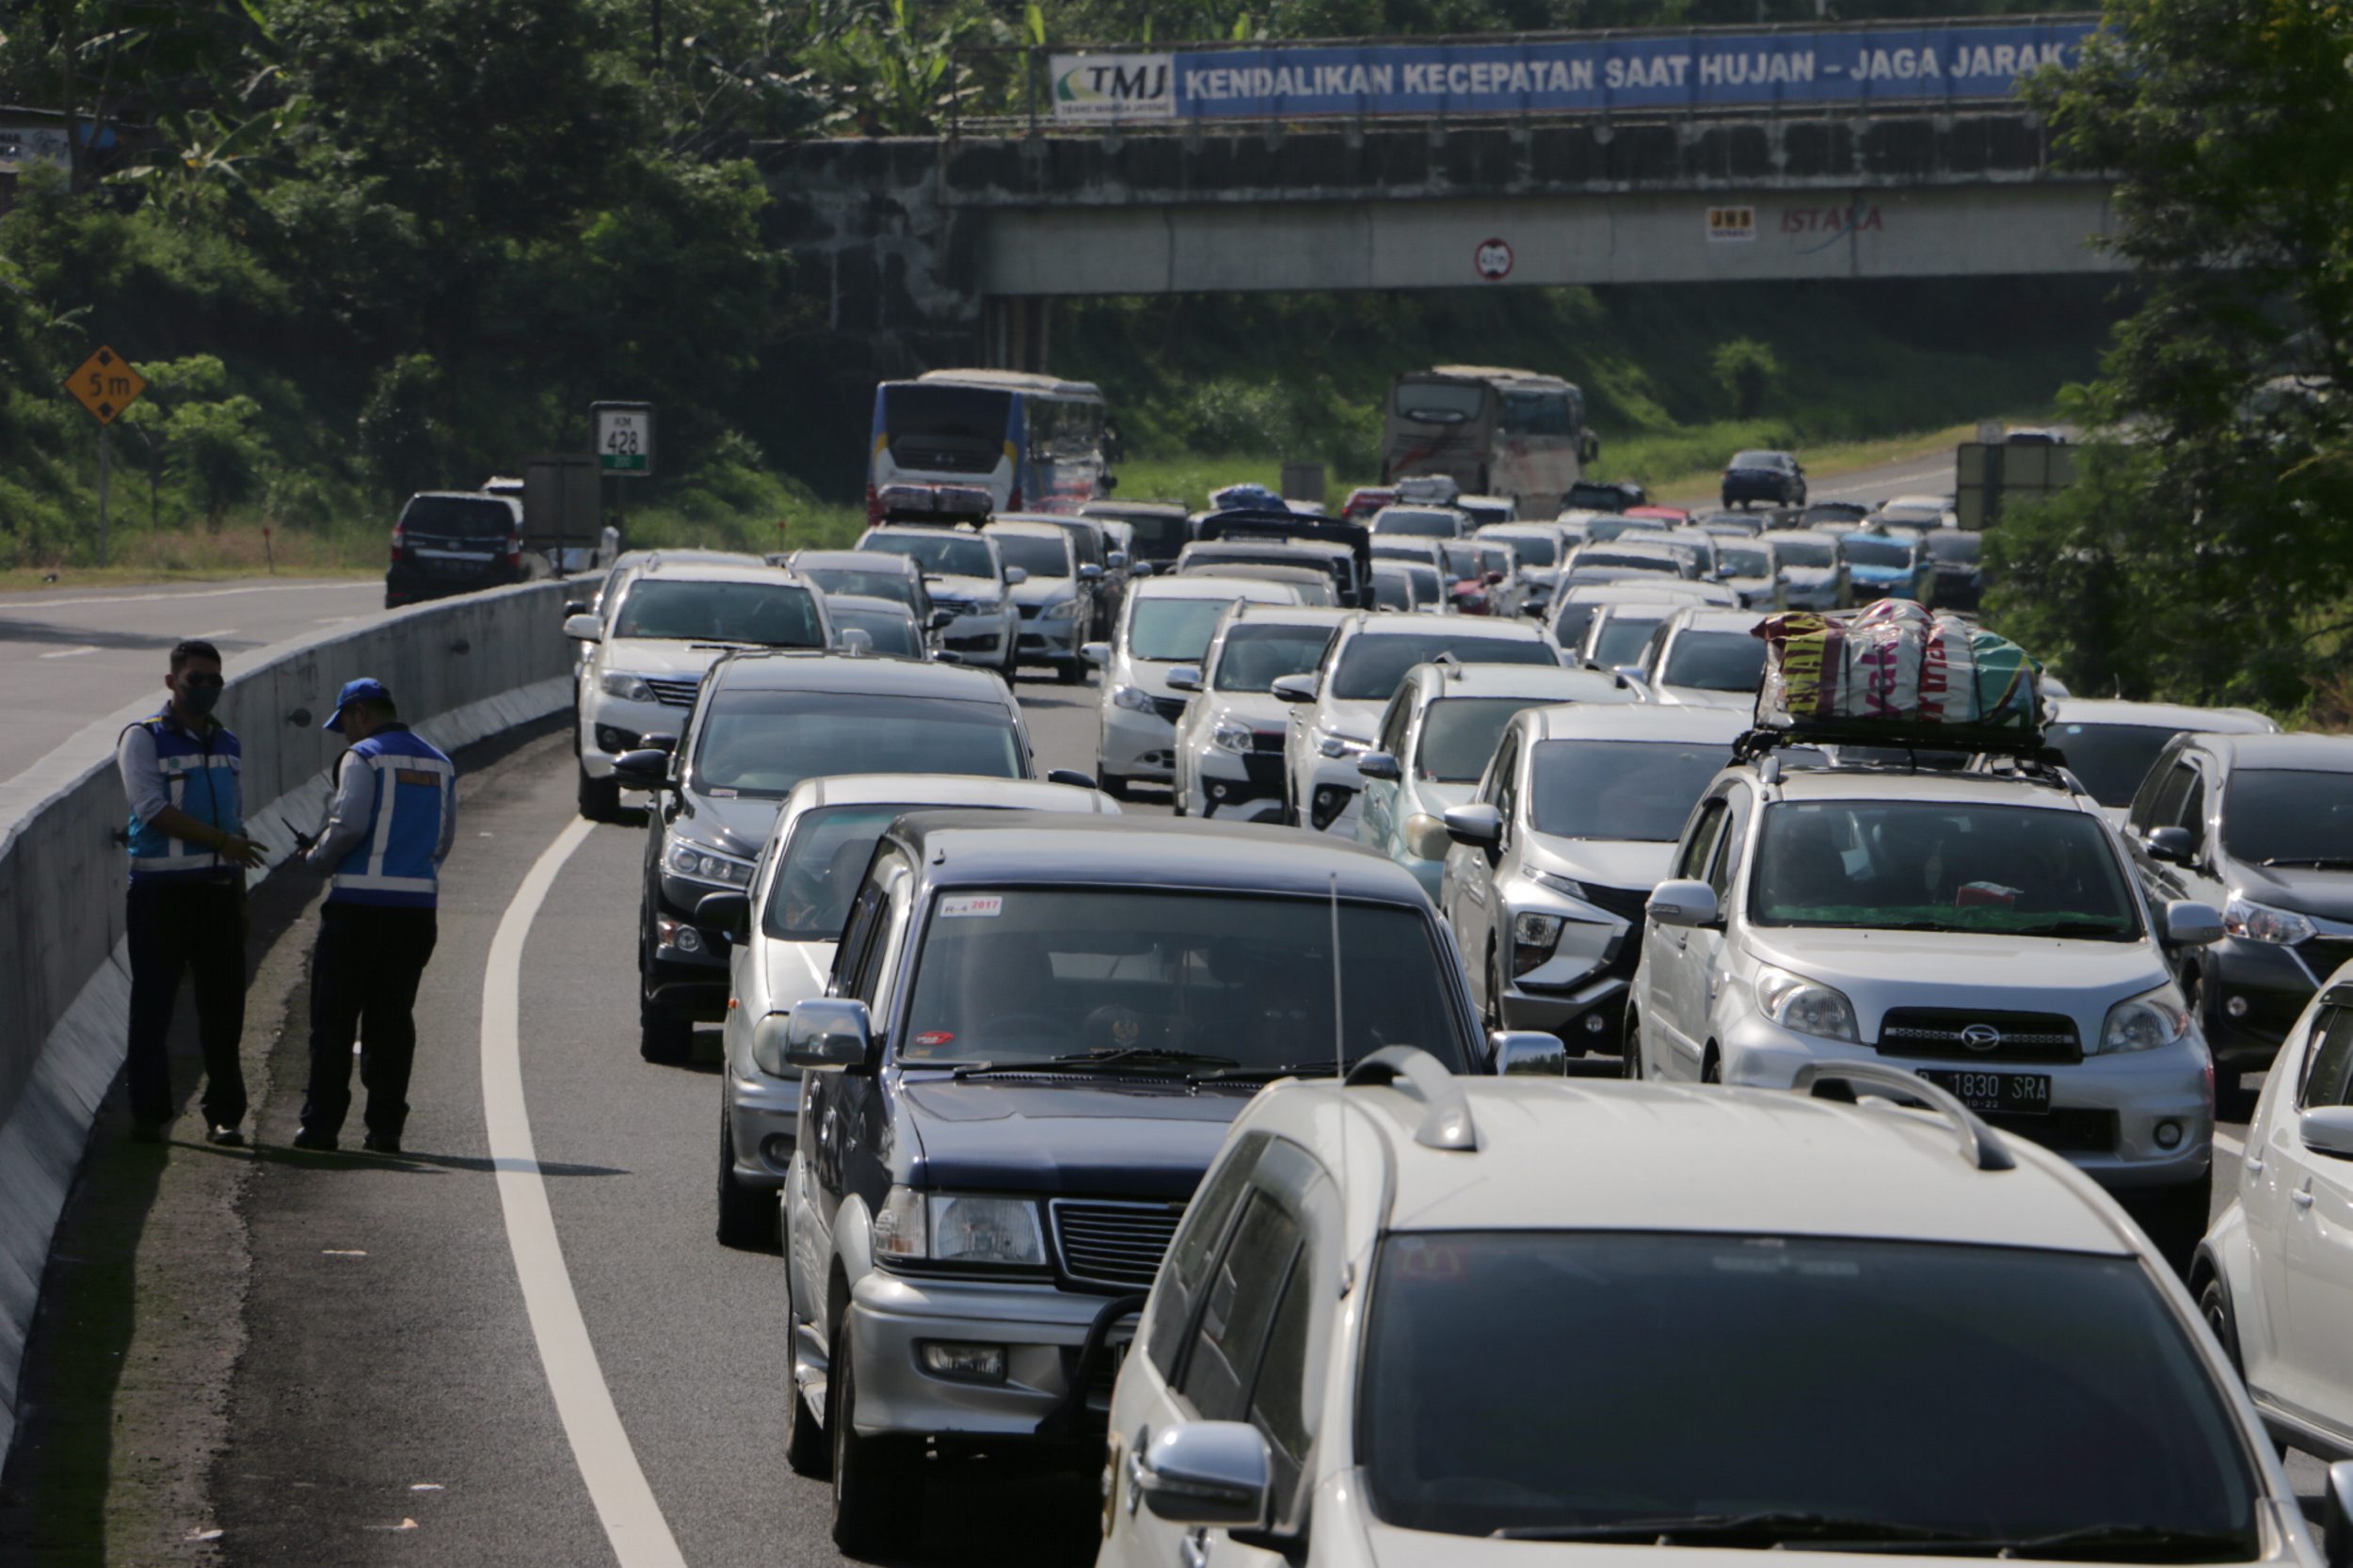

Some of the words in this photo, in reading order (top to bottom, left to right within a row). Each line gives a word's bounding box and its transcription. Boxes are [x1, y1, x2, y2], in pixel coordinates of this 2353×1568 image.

[1086, 64, 1167, 99] TMJ
[1185, 64, 1393, 101] KENDALIKAN
[1403, 58, 1593, 95] KECEPATAN
[1605, 55, 1690, 89] SAAT
[1700, 51, 1816, 86] HUJAN
[1849, 47, 1940, 81] JAGA
[1950, 41, 2064, 78] JARAK
[89, 373, 103, 396] 5
[108, 376, 130, 395] m
[614, 417, 632, 425] KM
[607, 430, 638, 455] 428
[970, 900, 999, 909] 2017
[1953, 1073, 1999, 1096] 1830
[2011, 1076, 2047, 1099] SRA
